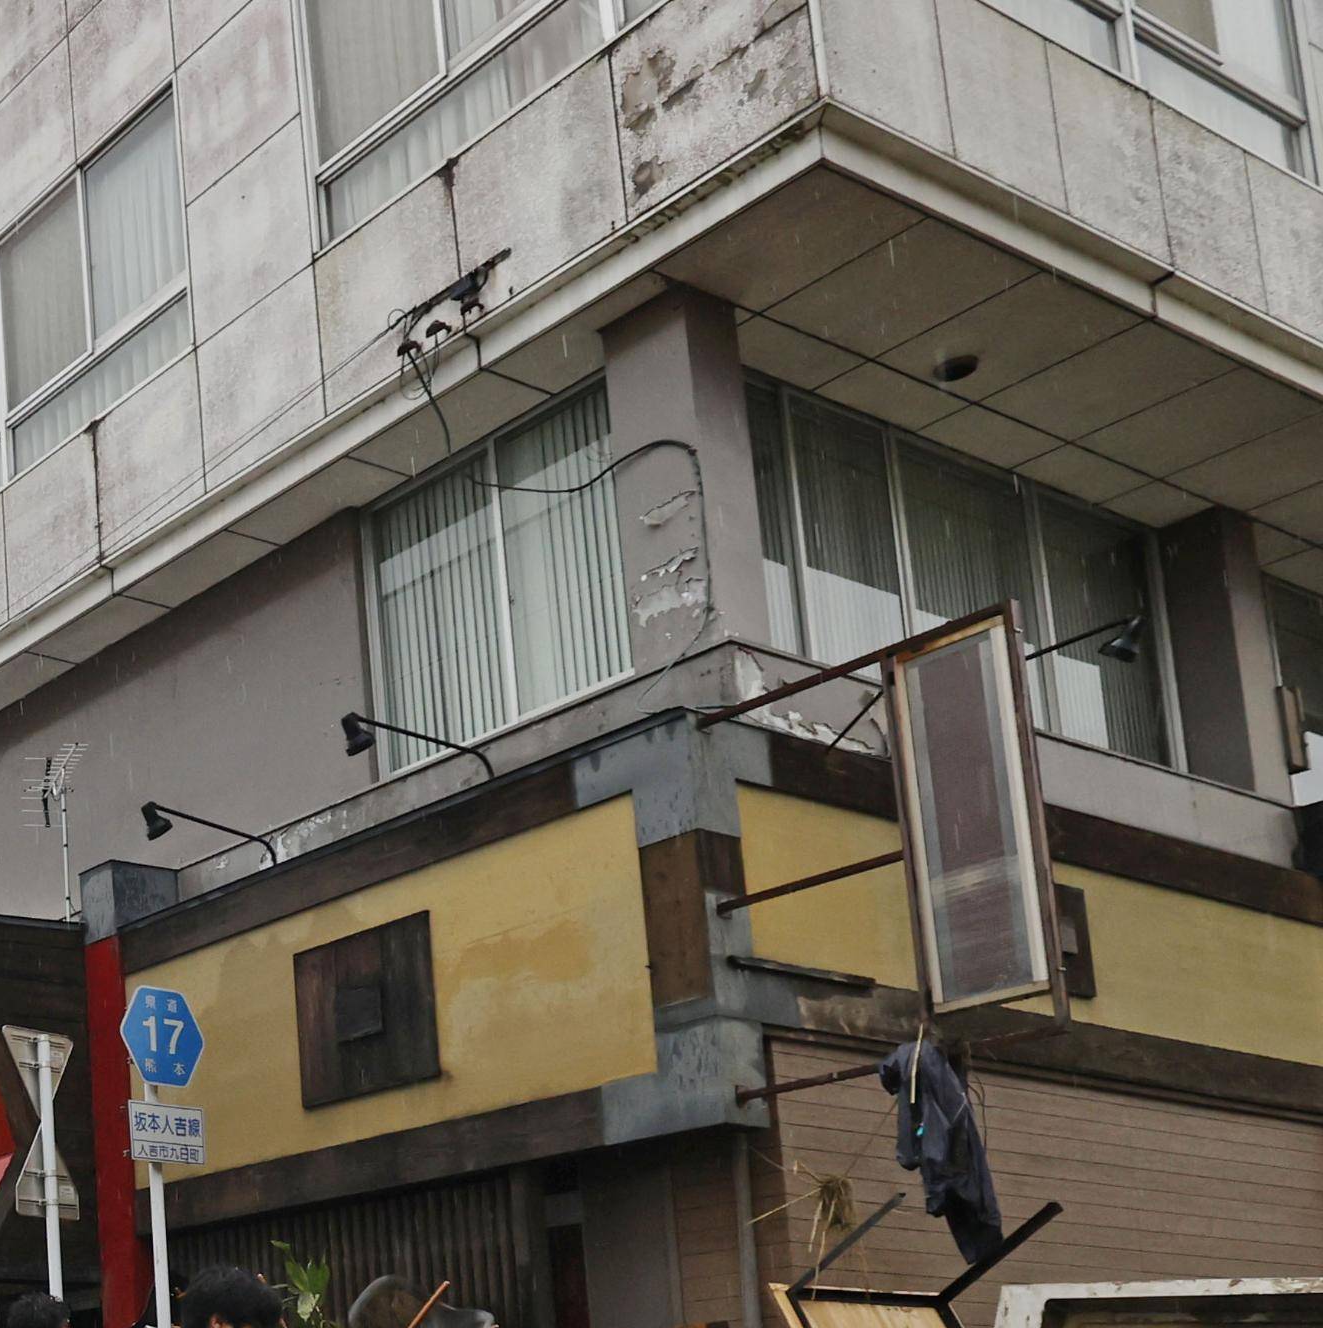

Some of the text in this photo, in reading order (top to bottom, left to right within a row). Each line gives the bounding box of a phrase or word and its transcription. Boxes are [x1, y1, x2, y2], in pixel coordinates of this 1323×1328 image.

[142, 1015, 184, 1055] 17
[145, 1058, 186, 1076] 熊本
[134, 1111, 201, 1138] 坂本人吉線
[138, 1145, 199, 1161] 人吉市九日町
